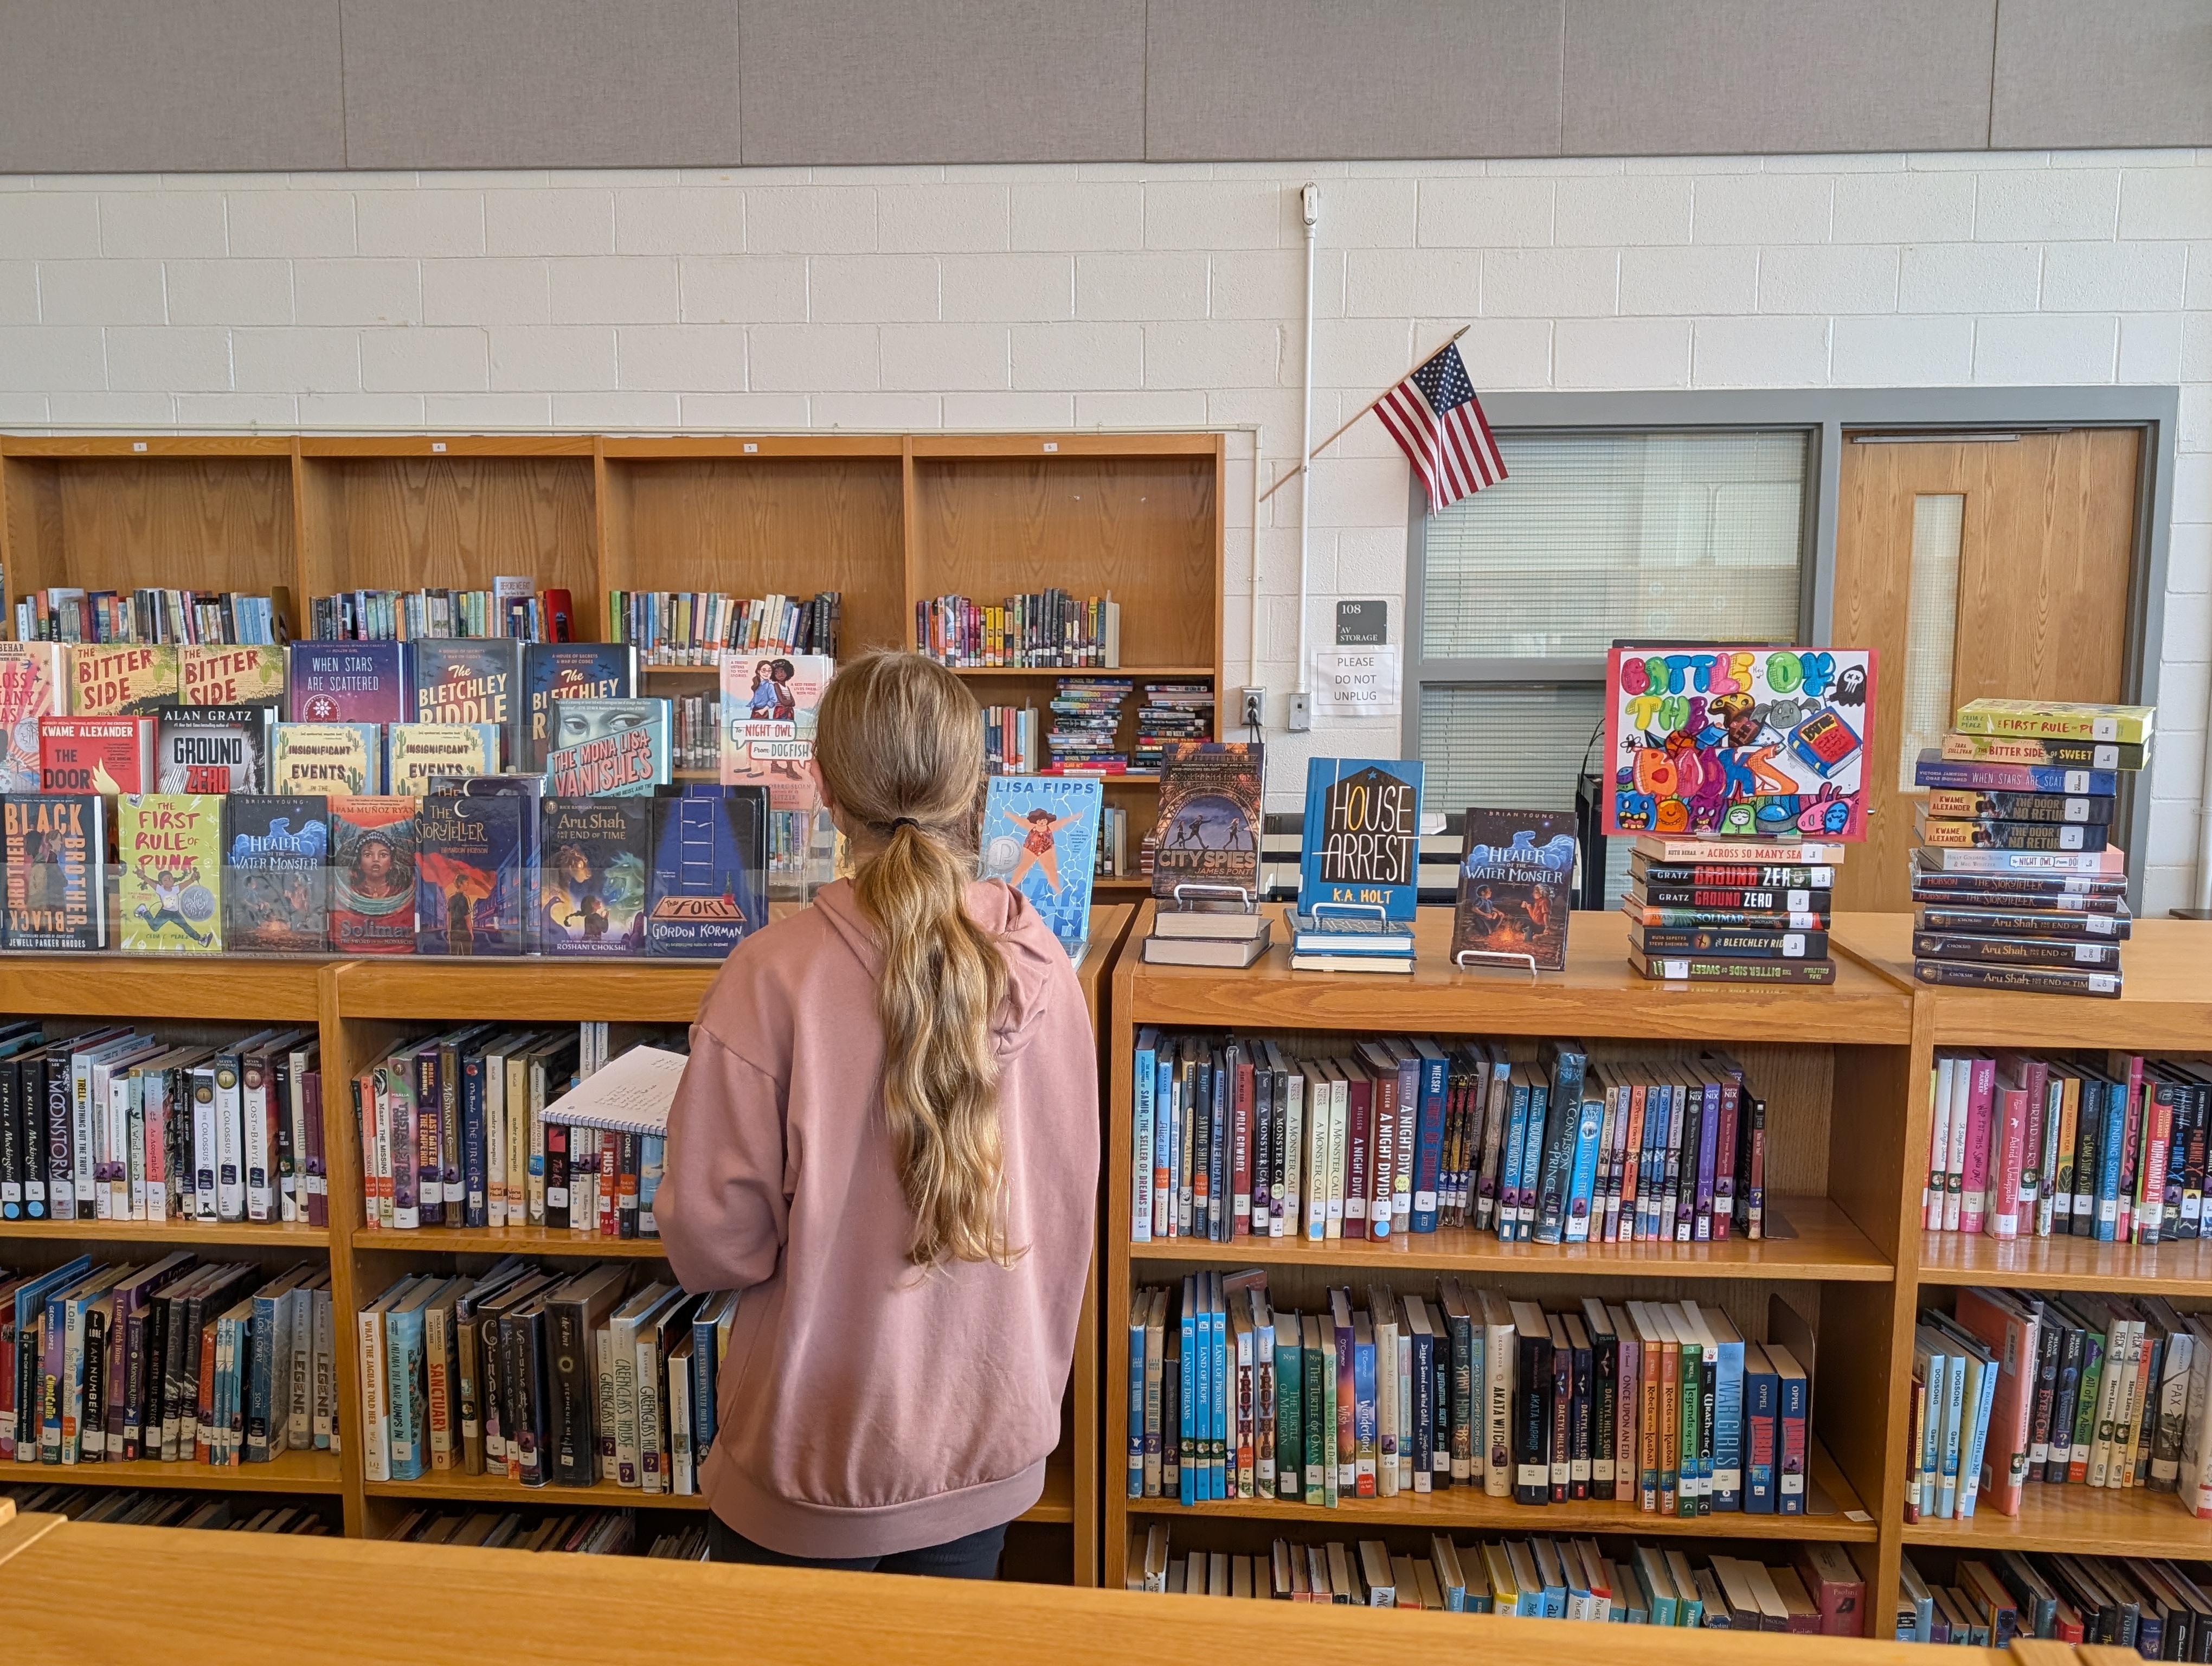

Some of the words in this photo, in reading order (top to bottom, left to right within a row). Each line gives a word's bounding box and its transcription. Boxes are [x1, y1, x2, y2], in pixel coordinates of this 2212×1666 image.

[1342, 604, 1361, 614] 108
[78, 648, 94, 658] THE
[1338, 657, 1374, 667] PLEASE
[79, 649, 155, 683] BITTER
[312, 657, 338, 671] WHEN
[345, 657, 373, 671] STARS
[448, 665, 472, 678] The
[307, 677, 323, 691] ARE
[330, 676, 379, 691] SCATTERED
[1335, 675, 1350, 684] DO
[1354, 675, 1377, 684] NOT
[1621, 652, 1755, 696] BATTLE
[1766, 651, 1836, 697] OF
[84, 677, 131, 709] SIDE
[419, 673, 507, 707] BLETCHLEY
[1334, 691, 1377, 700] UNPLUG
[164, 711, 201, 720] ALAN
[208, 711, 252, 721] GRATZ
[1625, 696, 1709, 732] THE
[42, 726, 74, 737] KWAME
[80, 726, 133, 737] ALEXANDER
[745, 725, 771, 738] NIGHT
[775, 725, 792, 738] OWL
[2003, 719, 2037, 732] FIRST
[2041, 721, 2070, 733] RULE
[55, 749, 78, 762] THE
[174, 738, 242, 764] GROUND
[289, 745, 351, 754] INSIGNIFICANT
[552, 748, 577, 773] THE
[580, 738, 618, 765] MONA
[620, 728, 651, 754] LISA
[771, 744, 809, 757] DOGFISH
[1989, 746, 2021, 757] BITTER
[2023, 748, 2043, 758] SIDE
[2059, 748, 2093, 760] SWEET
[43, 768, 90, 789] DOOR
[187, 765, 230, 793] ZERO
[292, 764, 345, 779] EVENTS
[554, 747, 653, 797] VANISHES
[1632, 746, 1799, 798] BOOKS
[995, 781, 1034, 794] LISA
[1043, 783, 1095, 794] FIPPS
[1331, 759, 1412, 833] HOUSE
[4, 803, 83, 836] BLACK
[139, 811, 200, 830] FIRST
[430, 805, 452, 819] THE
[558, 813, 587, 829] Aru
[590, 812, 626, 829] Shah
[415, 818, 487, 843] STORYTELLER
[136, 832, 188, 850] RULE
[188, 837, 199, 846] OF
[138, 854, 199, 871] PUNK
[1159, 850, 1201, 867] CITY
[1204, 851, 1256, 868] SPIES
[1312, 834, 1420, 882] ARREST
[1488, 846, 1545, 864] HEALER
[1707, 849, 1739, 858] ACROSS
[1741, 849, 1752, 858] SO
[1755, 849, 1784, 858] MANY
[7, 837, 24, 909] BROTHER
[1465, 867, 1506, 881] WATER
[1508, 868, 1563, 884] MONSTER
[1333, 888, 1356, 902] K.A.
[1360, 890, 1393, 905] HOLT
[1694, 891, 1740, 906] GROUND
[1744, 893, 1772, 907] ZERO
[673, 900, 729, 916] FORT
[10, 911, 64, 932] BLACK
[340, 920, 413, 938] Solimar
[652, 924, 695, 939] GORDON
[700, 924, 742, 938] KORMAN
[9, 938, 33, 947] JEWELL
[35, 939, 59, 947] PARKER
[62, 939, 86, 948] RHODES
[1724, 938, 1769, 948] BLETCHLEY
[1691, 964, 1720, 975] SWEET
[1729, 966, 1749, 975] SIDE
[1750, 966, 1780, 977] BITTER
[1983, 973, 2003, 983] Aru
[2005, 973, 2030, 985] Shah
[27, 1082, 33, 1092] TO
[1431, 1065, 1442, 1093] NIELSEN
[77, 1079, 86, 1099] TRELL
[1140, 1090, 1149, 1117] SAMIR,
[78, 1101, 86, 1127] NOTHING
[1236, 1111, 1246, 1132] POLO
[48, 1080, 67, 1181] MOONSTORM
[1140, 1119, 1149, 1132] THE
[25, 1129, 37, 1181] Mockingbird
[1140, 1135, 1148, 1161] SELLER
[1236, 1136, 1245, 1171] COWBOY
[79, 1156, 87, 1175] TRUTH
[1139, 1163, 1148, 1172] OF
[2147, 1140, 2164, 1189] MUHAMMAD
[1139, 1176, 1147, 1205] DREAMS
[364, 1321, 373, 1342] WHAT
[293, 1350, 306, 1414] LEGEND
[366, 1360, 375, 1388] JAGUAR
[615, 1359, 633, 1414] GREENGLASS
[1280, 1383, 1288, 1395] OF
[1623, 1375, 1631, 1400] ONCE
[1953, 1370, 1962, 1407] DOGSONG
[2170, 1383, 2183, 1406] PAX
[368, 1391, 376, 1409] TOLD
[429, 1363, 446, 1432] SANCTUARY
[1290, 1389, 1299, 1407] THE
[1493, 1386, 1505, 1415] AKATA
[1718, 1380, 1740, 1413] WAR
[1279, 1397, 1288, 1445] MICHIGAN
[1290, 1410, 1298, 1440] TURTLE
[1622, 1403, 1630, 1429] UPON
[618, 1420, 634, 1448] HOUSE
[1359, 1400, 1372, 1453] Wonderland
[1493, 1419, 1505, 1447] WITCH
[1622, 1430, 1630, 1442] AN
[1622, 1444, 1630, 1459] EID
[1716, 1420, 1739, 1465] GIRLS
